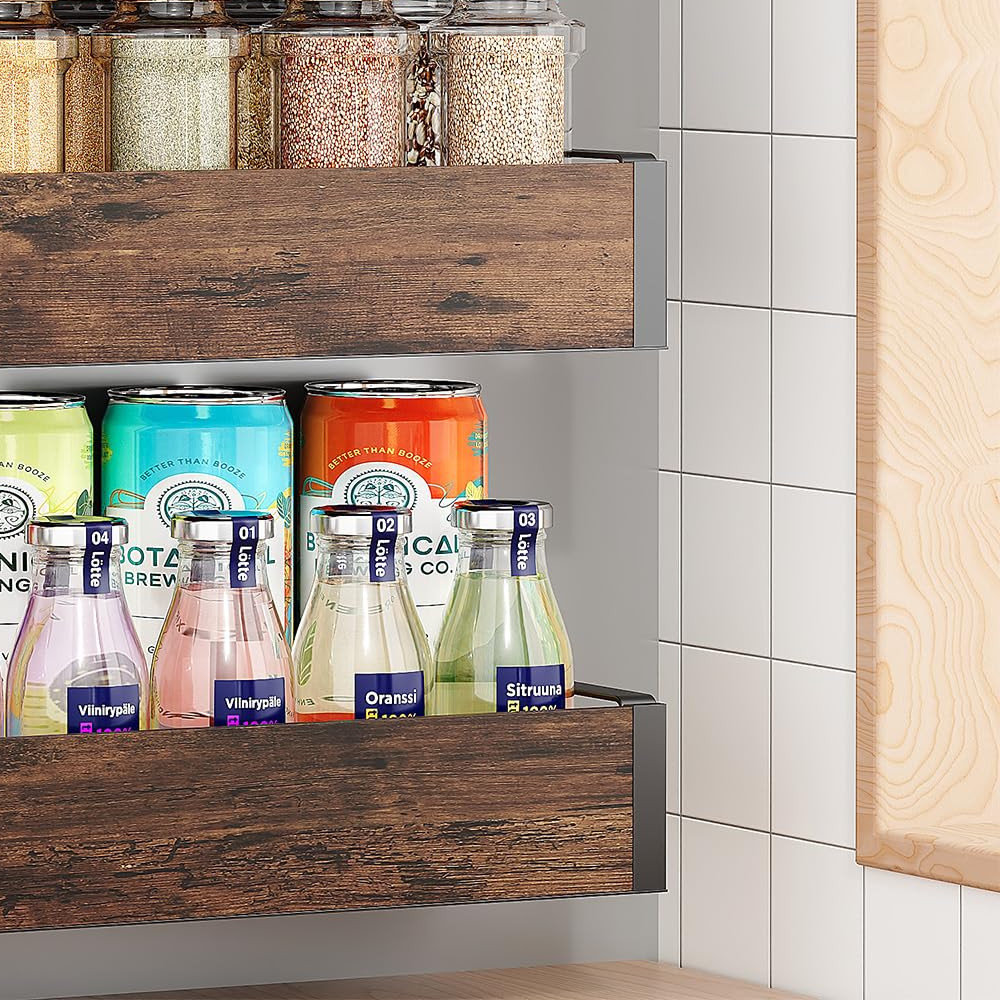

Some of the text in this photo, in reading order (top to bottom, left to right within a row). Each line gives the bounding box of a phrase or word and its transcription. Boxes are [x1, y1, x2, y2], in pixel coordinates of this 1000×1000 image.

[328, 448, 362, 470] BETTER
[398, 449, 432, 470] BOOZE
[18, 463, 50, 482] BOOZE
[140, 460, 174, 481] BETTER
[214, 460, 246, 480] BOOZE
[376, 517, 395, 533] 02
[518, 512, 536, 527] 03
[91, 531, 110, 546] 04
[239, 526, 256, 540] 01
[375, 540, 390, 578] Lötte
[517, 533, 532, 570] Lötte
[90, 552, 104, 588] Lötte
[238, 546, 252, 582] Lötte
[420, 560, 453, 575] CO.
[366, 689, 416, 705] Oranssi
[506, 682, 562, 696] Sitruuna
[78, 703, 136, 718] Viinirypäle
[225, 696, 282, 711] Viinirypäle
